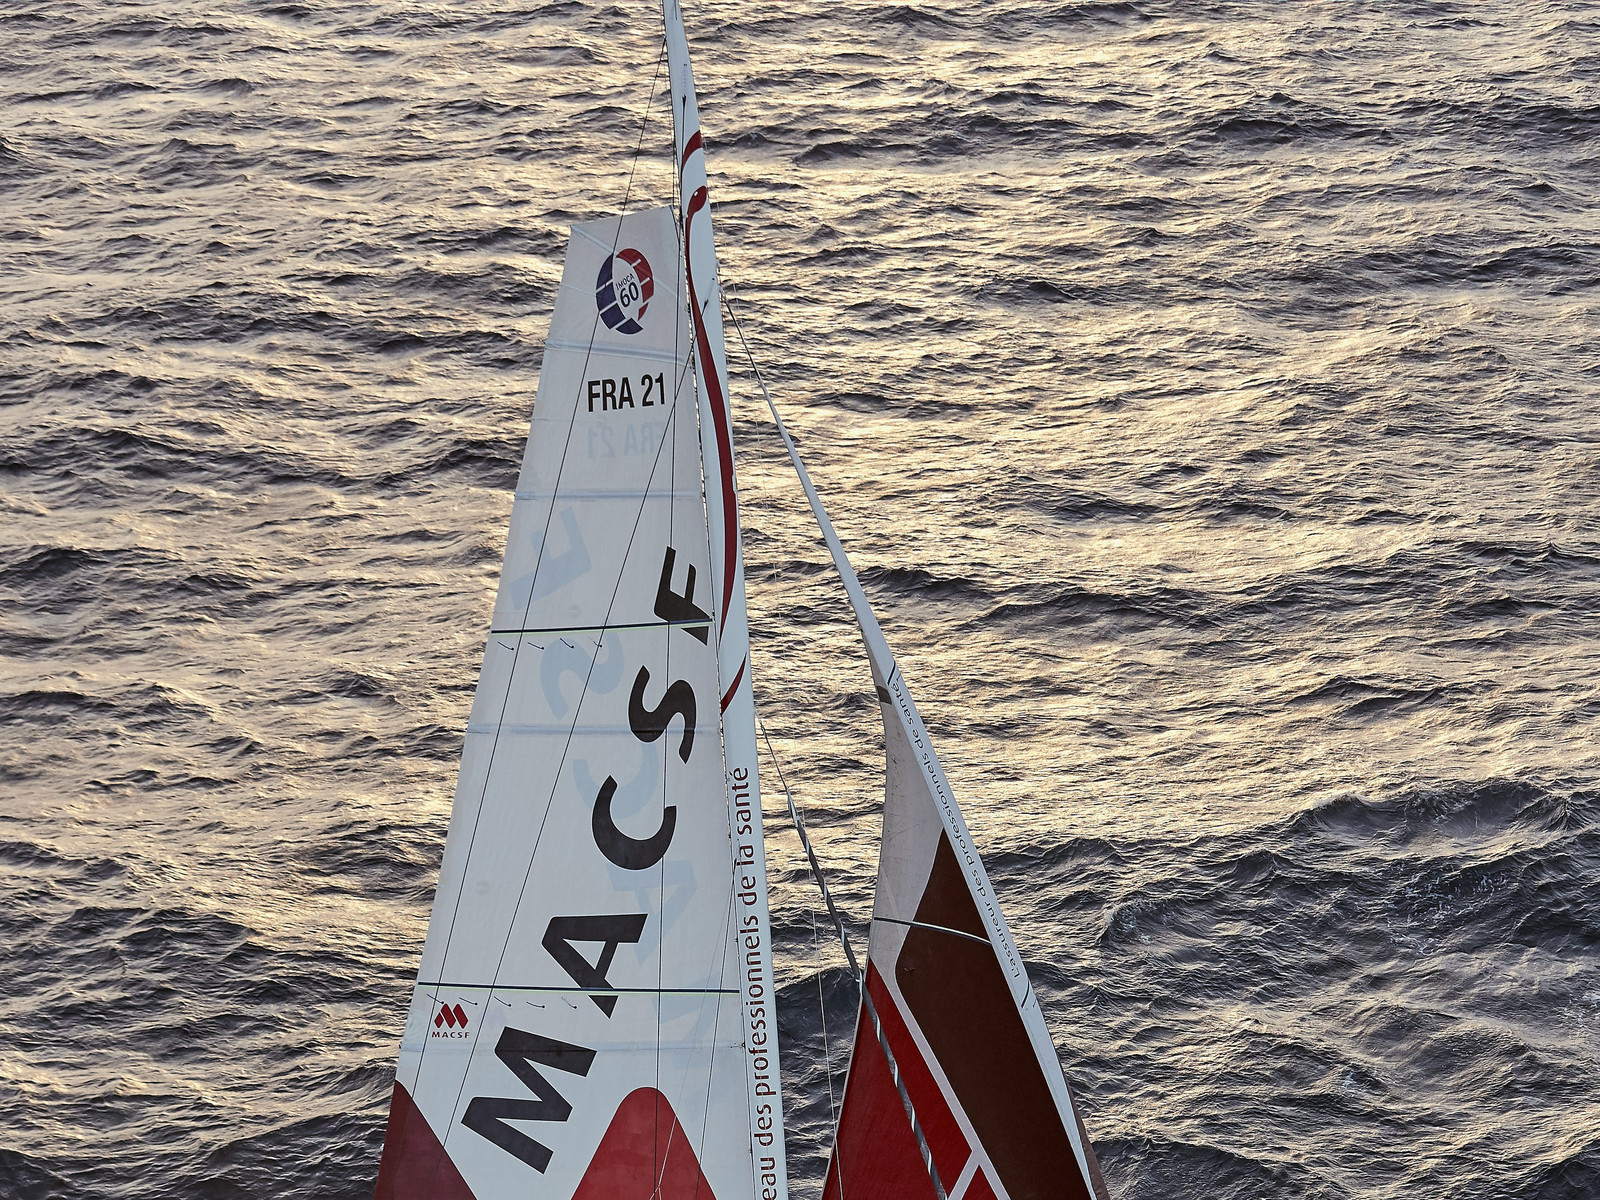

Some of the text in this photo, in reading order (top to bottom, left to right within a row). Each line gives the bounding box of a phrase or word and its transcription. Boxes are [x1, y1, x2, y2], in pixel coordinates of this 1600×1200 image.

[620, 282, 639, 307] 60
[587, 372, 665, 412] FRA 21
[729, 767, 752, 835] santé
[461, 546, 714, 1174] MACSF
[736, 844, 755, 866] la
[737, 876, 758, 906] de
[739, 915, 777, 1096] professionnels
[431, 1030, 470, 1039] MACSF
[753, 1104, 774, 1147] des
